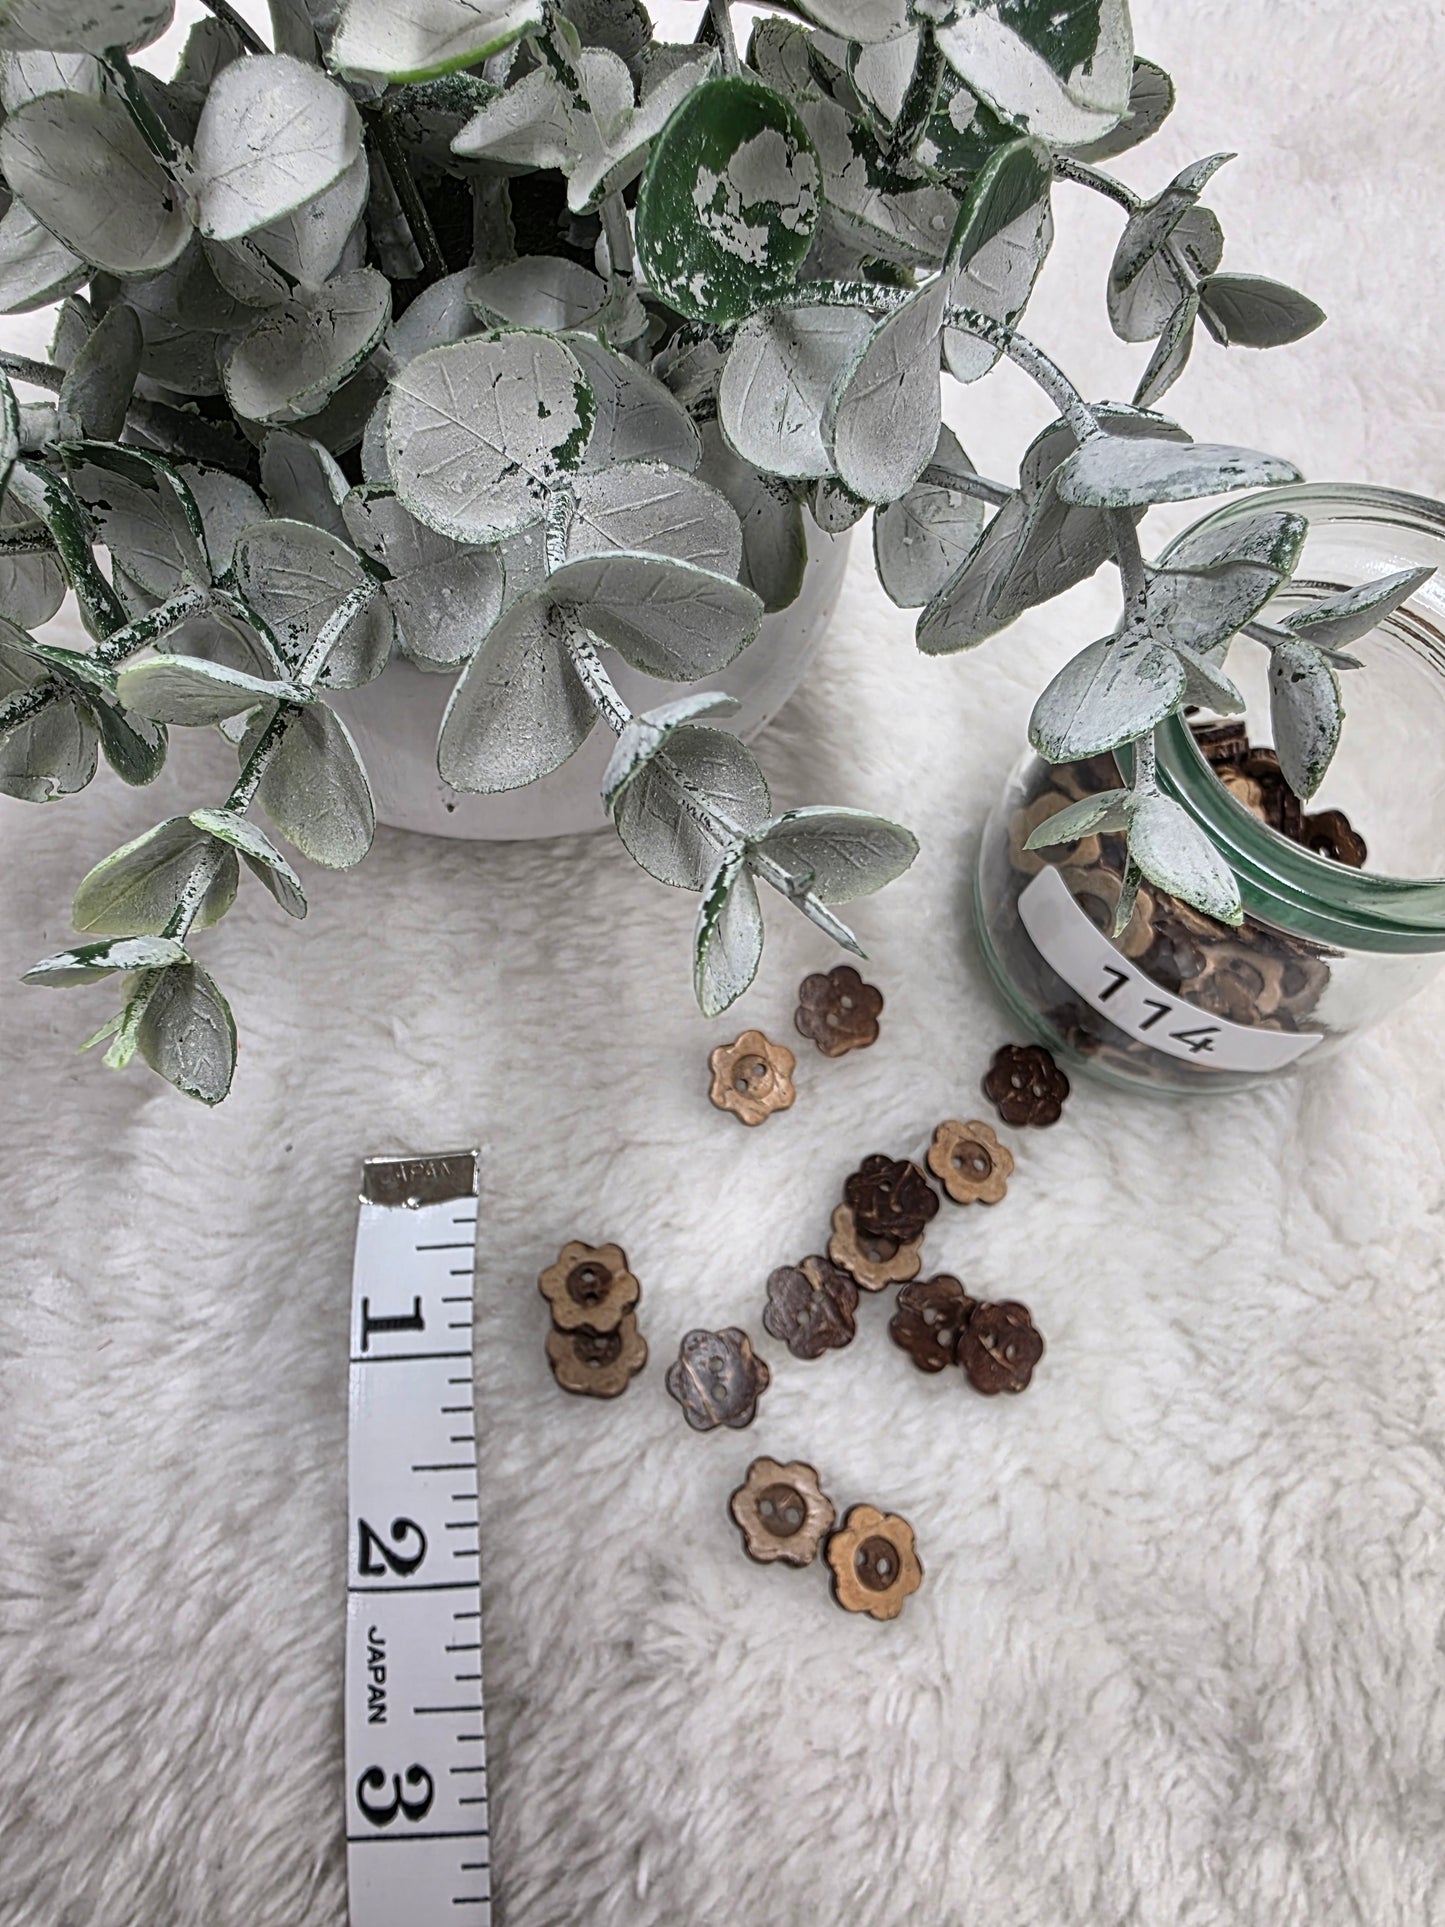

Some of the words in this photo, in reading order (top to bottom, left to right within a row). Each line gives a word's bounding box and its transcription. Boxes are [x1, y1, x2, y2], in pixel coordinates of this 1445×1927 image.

[1099, 965, 1221, 1053] 114
[361, 1296, 424, 1352] 1
[358, 1517, 427, 1577] 2
[367, 1625, 387, 1724] JAPAN
[356, 1763, 435, 1828] 3
